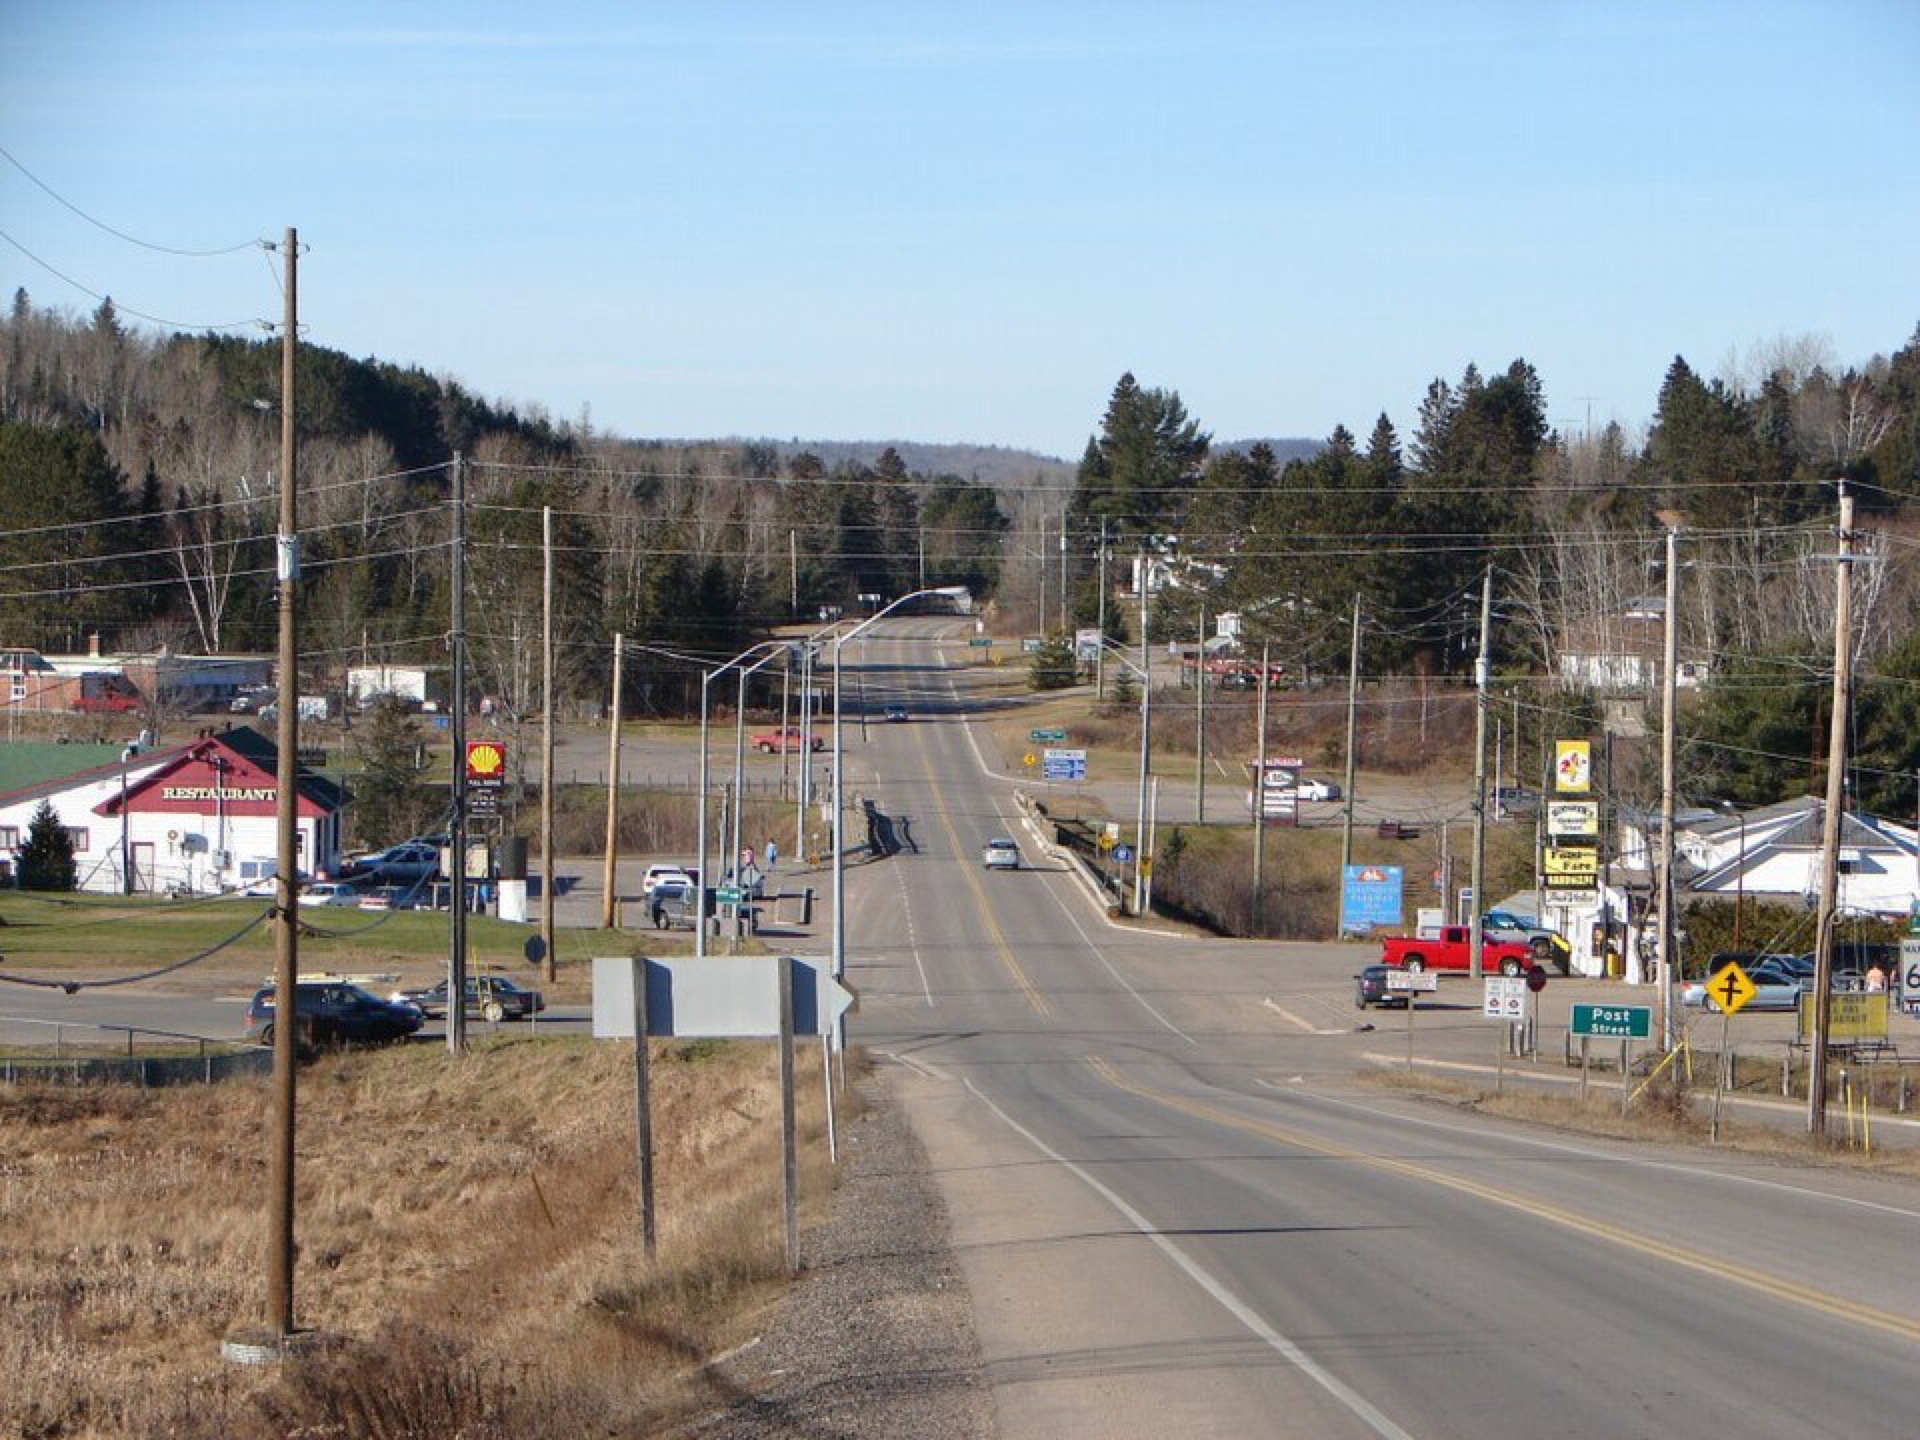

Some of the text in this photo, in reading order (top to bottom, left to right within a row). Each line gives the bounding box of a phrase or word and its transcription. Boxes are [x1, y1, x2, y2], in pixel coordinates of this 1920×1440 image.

[162, 787, 278, 800] RESTAURANT
[1591, 1007, 1631, 1022] Post
[1591, 1023, 1631, 1035] Street
